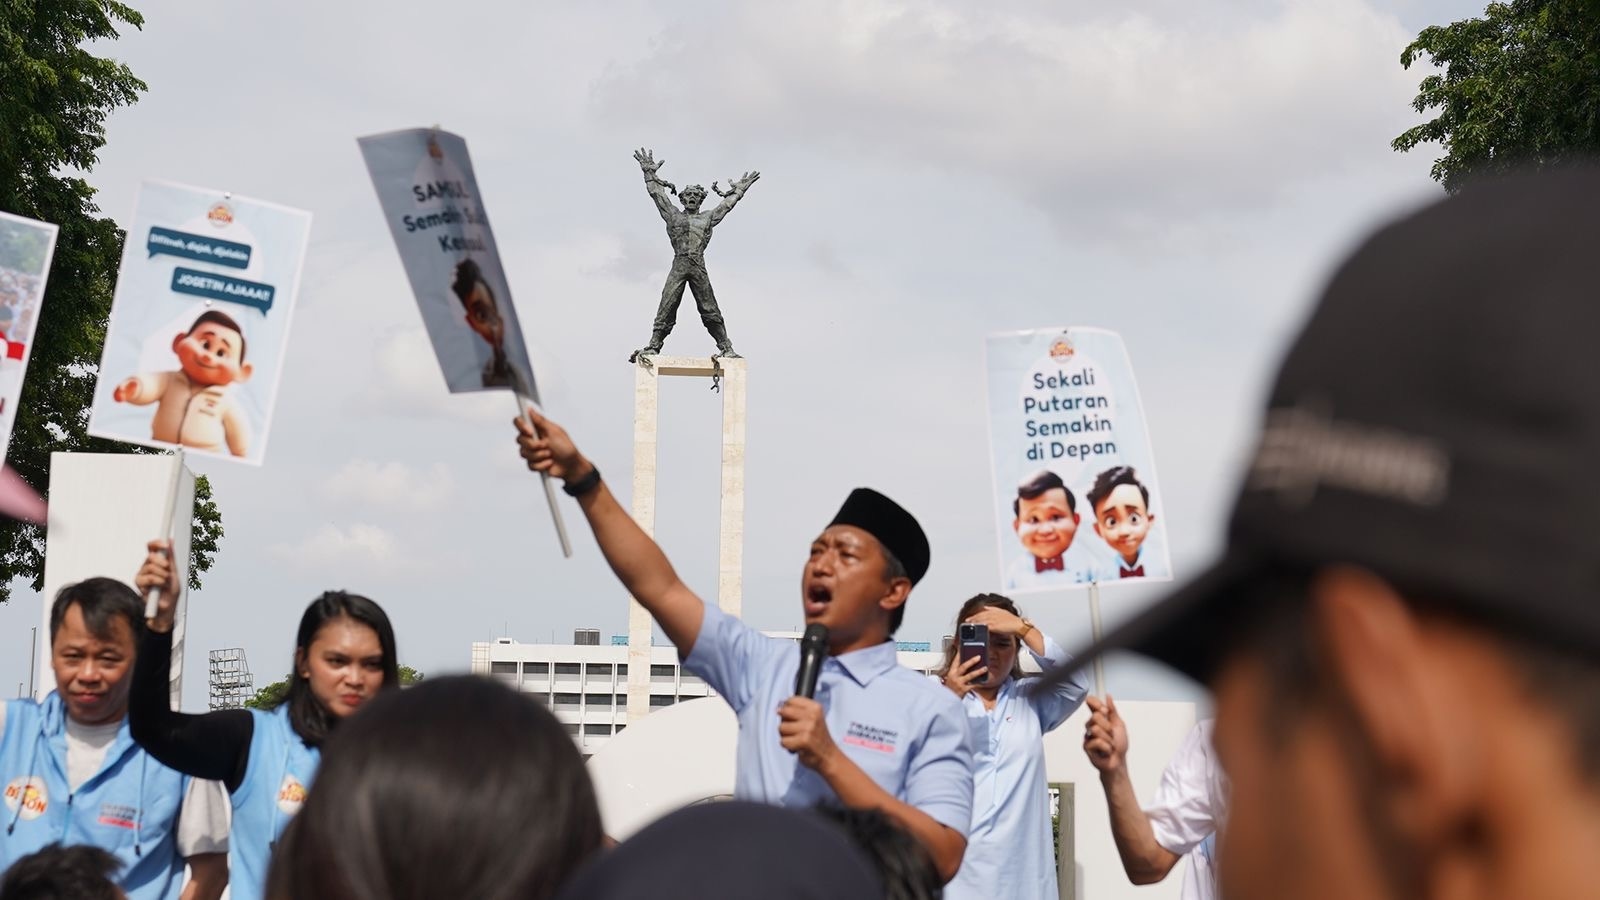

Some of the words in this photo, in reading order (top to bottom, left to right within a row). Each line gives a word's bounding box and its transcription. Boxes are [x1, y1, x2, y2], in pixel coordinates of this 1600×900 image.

[177, 273, 225, 292] JOGETIN
[1033, 368, 1095, 390] Sekali
[1024, 396, 1109, 414] Putaran
[1025, 414, 1112, 438] Semakin
[1027, 442, 1044, 460] di
[1050, 441, 1117, 461] Depan
